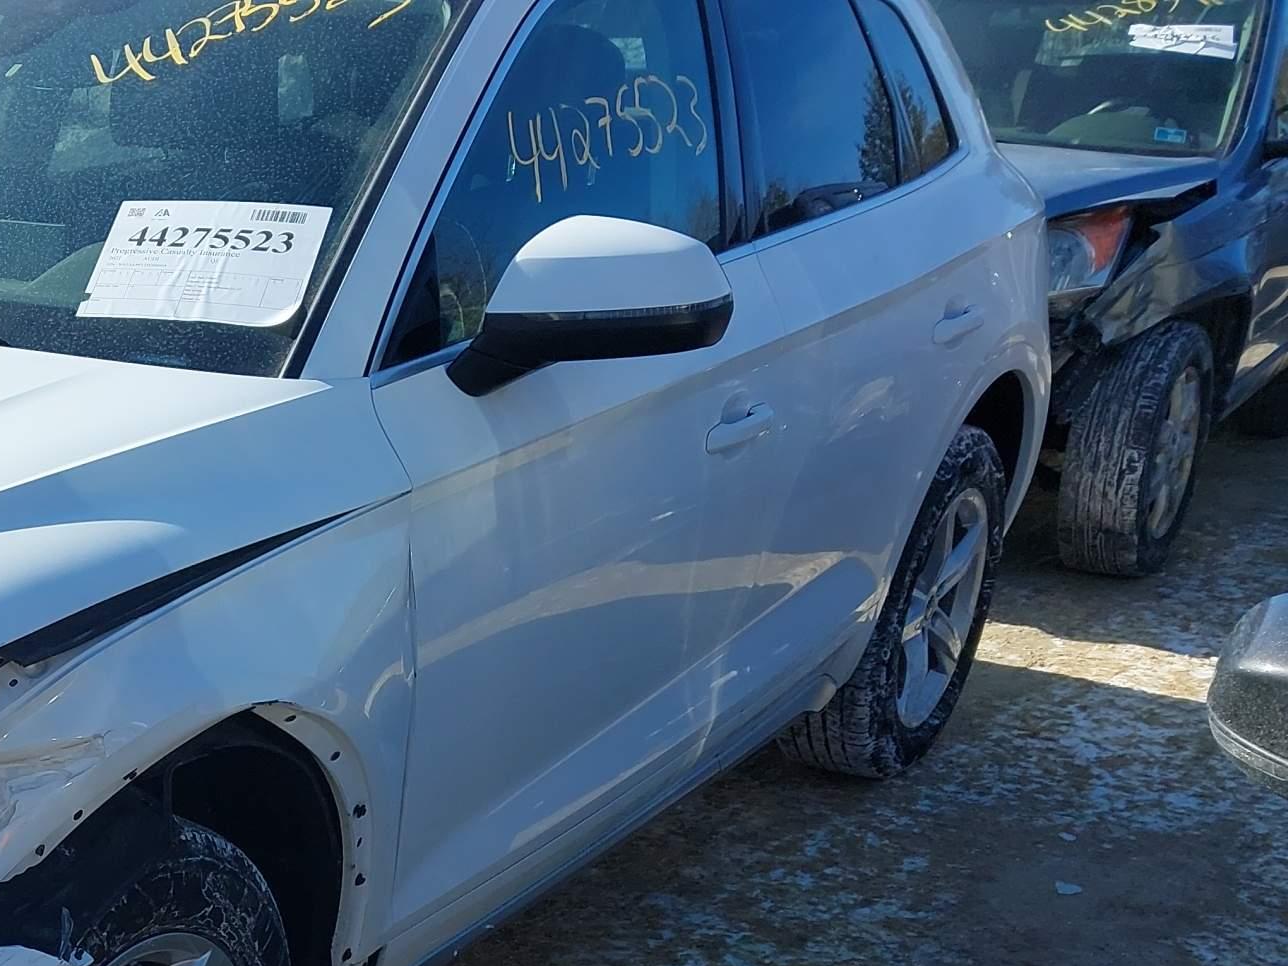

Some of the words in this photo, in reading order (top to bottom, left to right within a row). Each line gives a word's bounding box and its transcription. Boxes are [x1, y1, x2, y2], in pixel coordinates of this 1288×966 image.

[90, 0, 412, 83] 44275
[507, 75, 707, 203] 44275523
[111, 247, 159, 256] Progressive
[160, 248, 195, 257] Casualty
[199, 249, 241, 258] Insurance
[127, 226, 295, 253] 44275523
